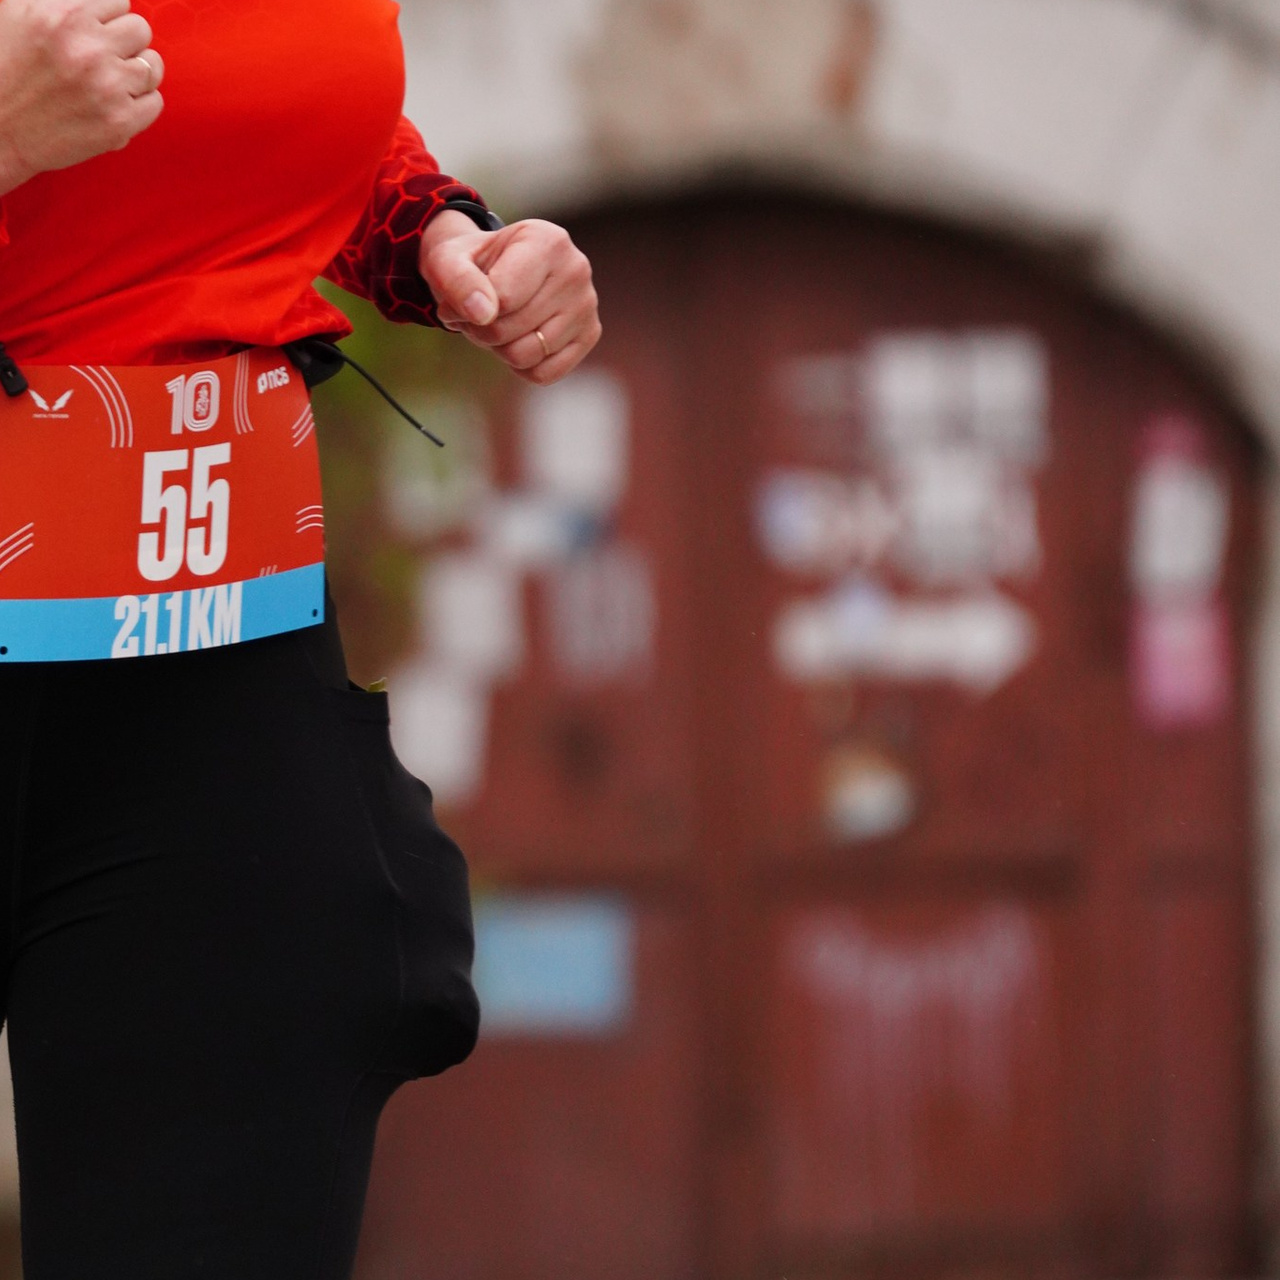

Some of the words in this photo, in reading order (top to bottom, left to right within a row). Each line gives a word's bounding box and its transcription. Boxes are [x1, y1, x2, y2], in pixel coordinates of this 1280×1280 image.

[166, 370, 220, 435] 10
[137, 442, 231, 582] 55
[111, 592, 185, 659] 21.1
[187, 581, 243, 652] KM
